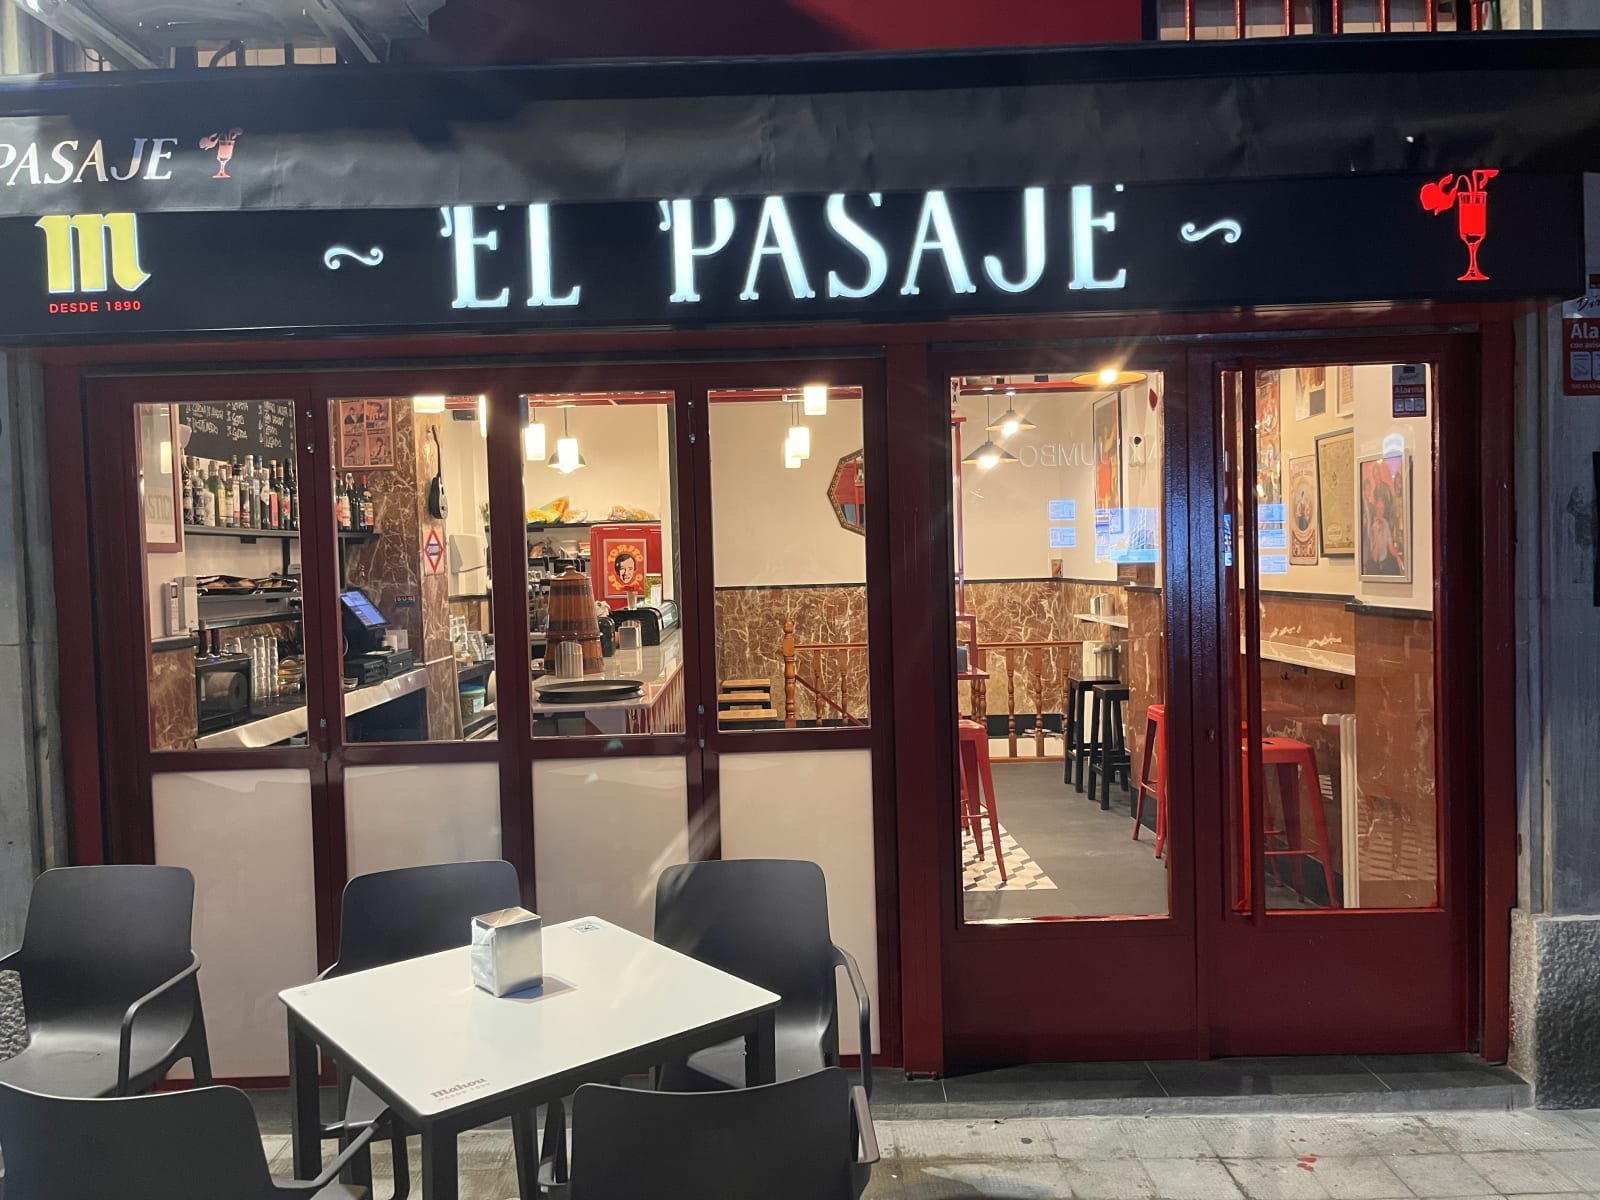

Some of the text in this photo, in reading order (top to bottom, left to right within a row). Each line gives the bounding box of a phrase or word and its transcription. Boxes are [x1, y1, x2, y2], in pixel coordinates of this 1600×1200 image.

[439, 184, 1128, 309] EL PASAJE
[49, 300, 142, 314] DESDE 1890
